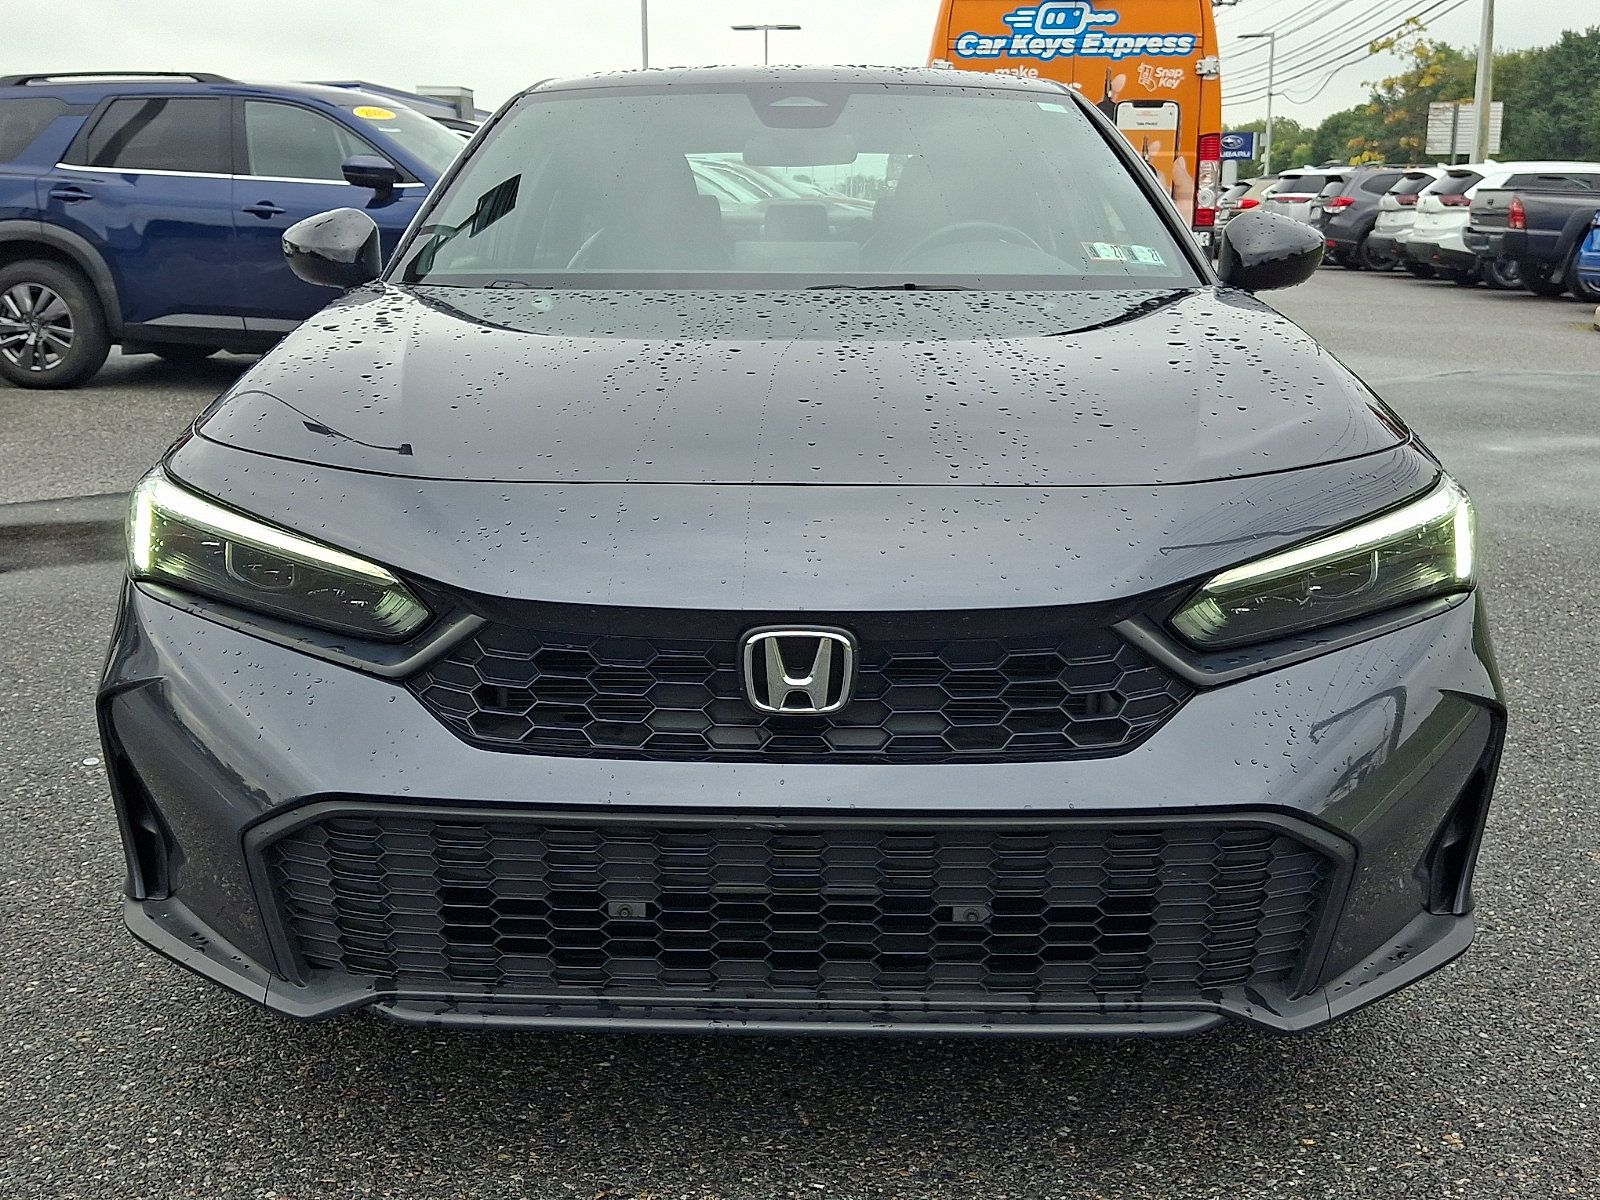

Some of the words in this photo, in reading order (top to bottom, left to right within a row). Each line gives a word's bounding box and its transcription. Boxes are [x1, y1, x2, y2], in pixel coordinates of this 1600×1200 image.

[957, 34, 1006, 56] Car
[1009, 34, 1076, 59] Keys
[1080, 33, 1193, 58] Express
[994, 65, 1039, 79] make
[1155, 67, 1183, 79] Snap
[1158, 77, 1181, 90] Key
